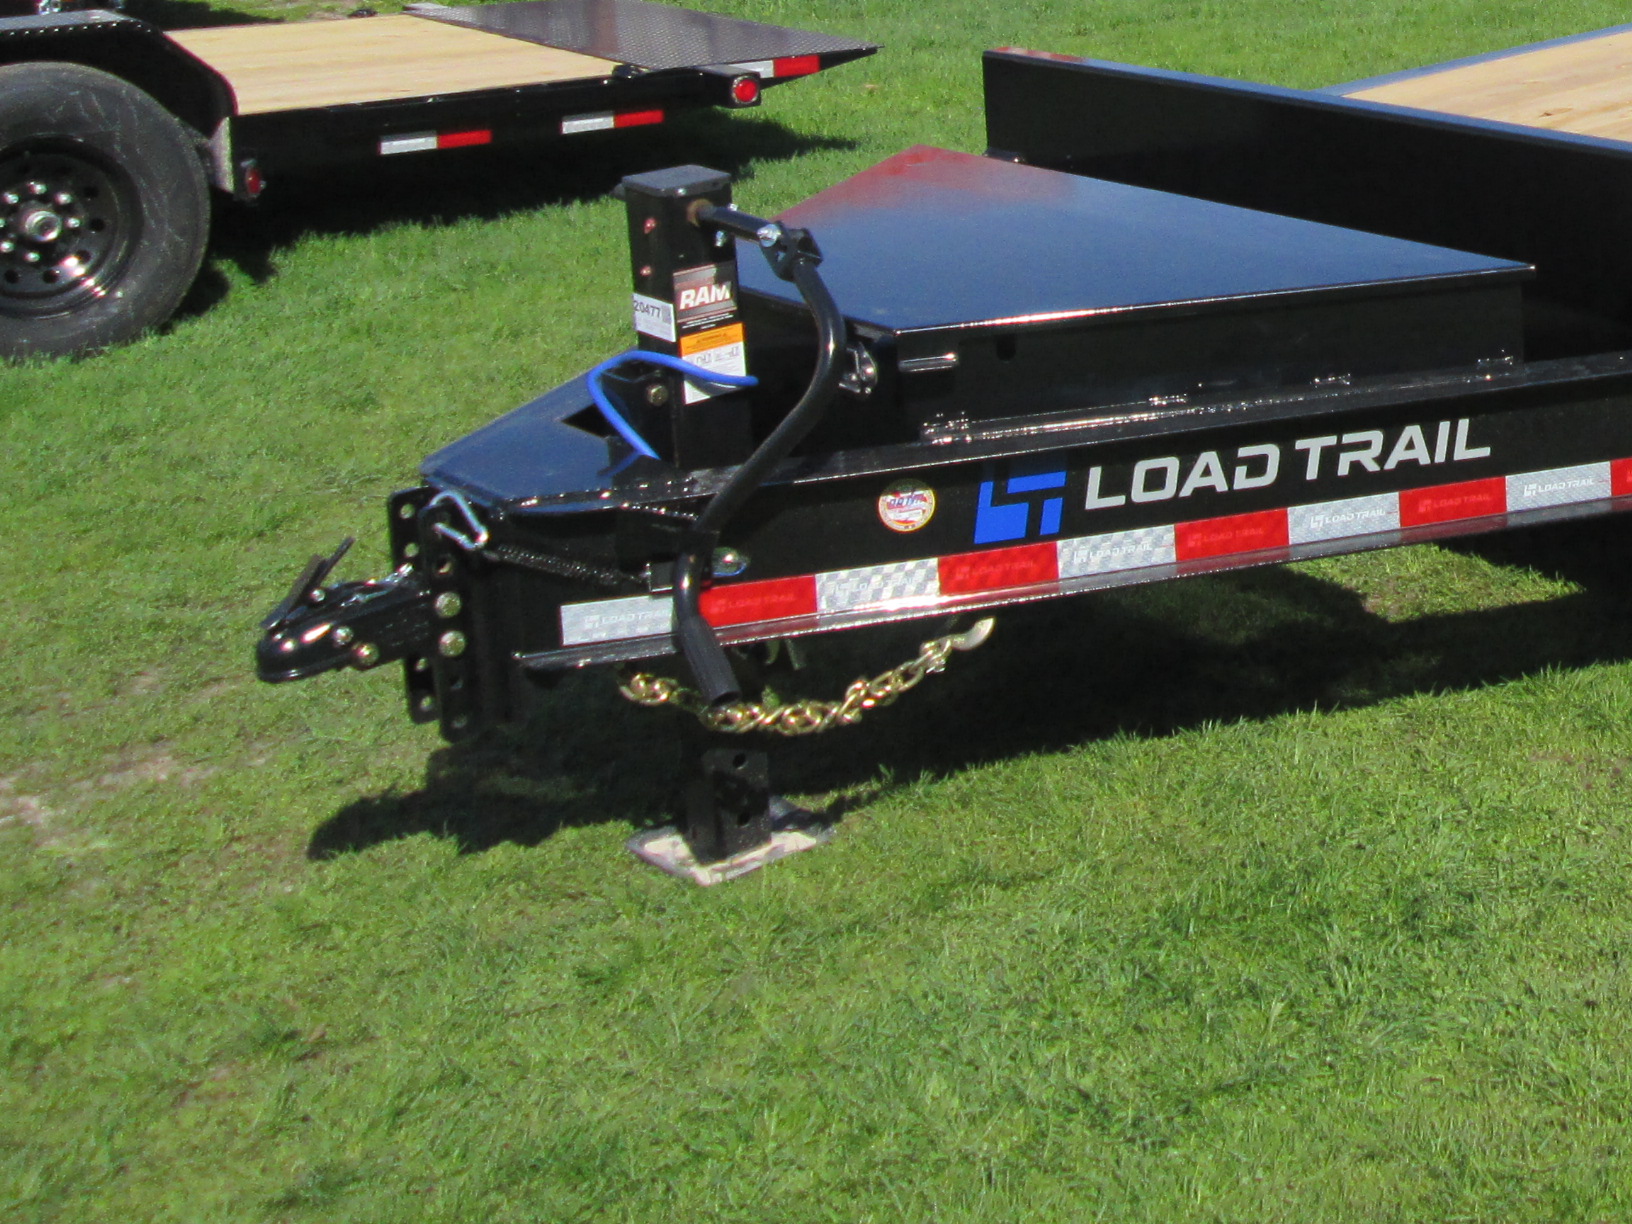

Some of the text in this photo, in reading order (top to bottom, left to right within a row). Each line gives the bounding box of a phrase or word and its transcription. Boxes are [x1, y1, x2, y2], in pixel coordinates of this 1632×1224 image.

[679, 282, 732, 310] RAM
[1085, 442, 1281, 510] LOAD
[1295, 418, 1492, 480] TRAIL
